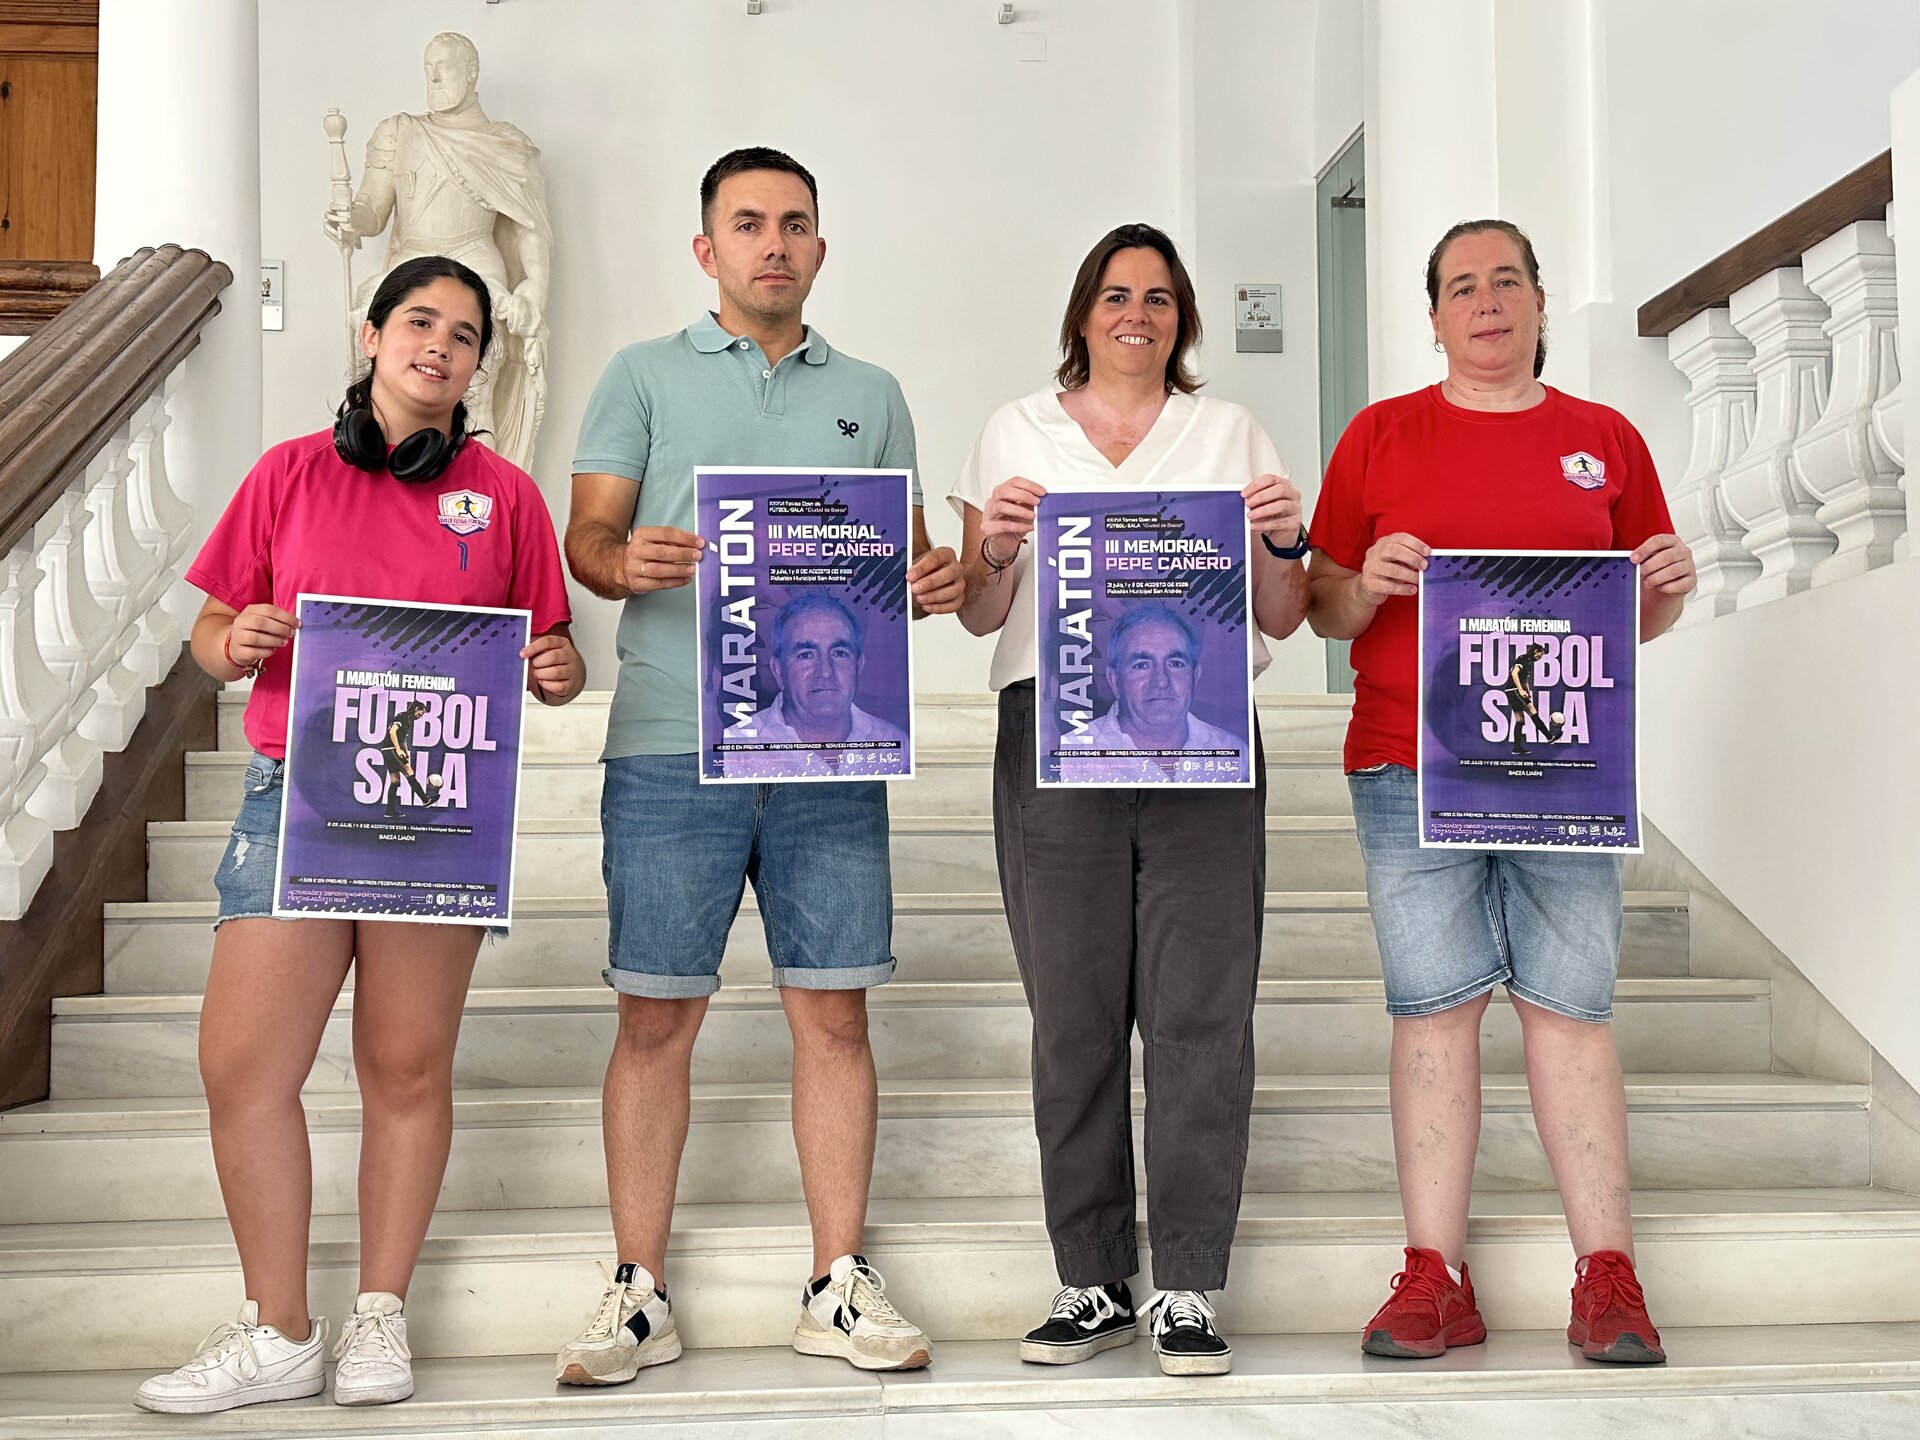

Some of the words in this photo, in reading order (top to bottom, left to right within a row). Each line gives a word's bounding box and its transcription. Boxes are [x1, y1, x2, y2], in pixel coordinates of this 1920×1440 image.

[768, 525, 782, 539] III
[787, 525, 882, 540] MEMORIAL
[768, 543, 817, 557] PEPE
[821, 539, 894, 557] CAÑERO
[1105, 540, 1119, 554] III
[1124, 539, 1218, 554] MEMORIAL
[1105, 557, 1153, 570] PEPE
[1158, 553, 1232, 570] CAÑERO
[708, 500, 758, 738] MARATÓN
[1469, 616, 1518, 632] MARATÓN
[1520, 619, 1571, 633] FEMENINA
[1048, 516, 1094, 745] MARATÓN
[1459, 632, 1614, 688] FÚTBOL
[346, 670, 400, 688] MARATÓN
[402, 675, 456, 692] FEMENINA
[332, 686, 496, 751] FÚTBOL
